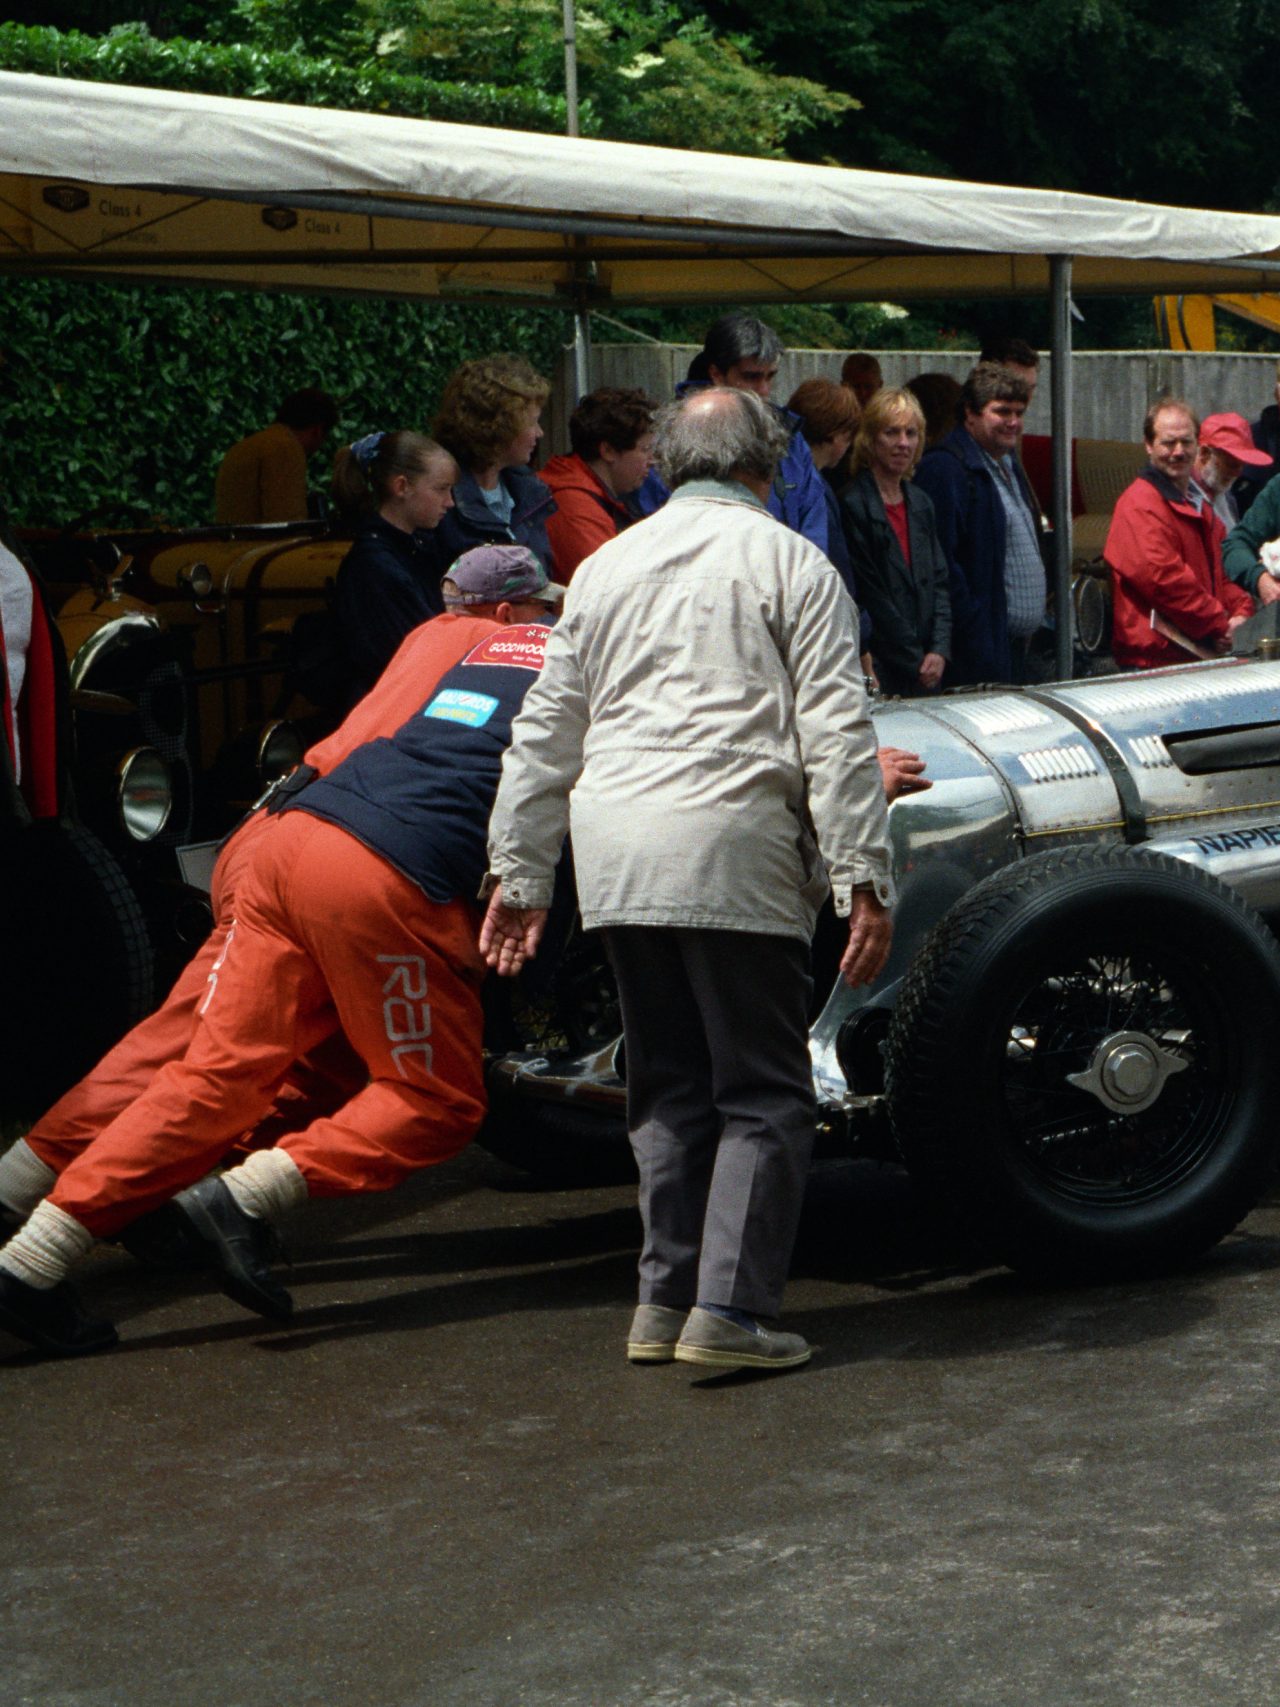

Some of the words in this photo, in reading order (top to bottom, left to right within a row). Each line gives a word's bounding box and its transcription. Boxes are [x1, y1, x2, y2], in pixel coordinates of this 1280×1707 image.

[99, 200, 131, 217] Class
[134, 204, 142, 217] 4
[488, 642, 545, 656] GOODWOO
